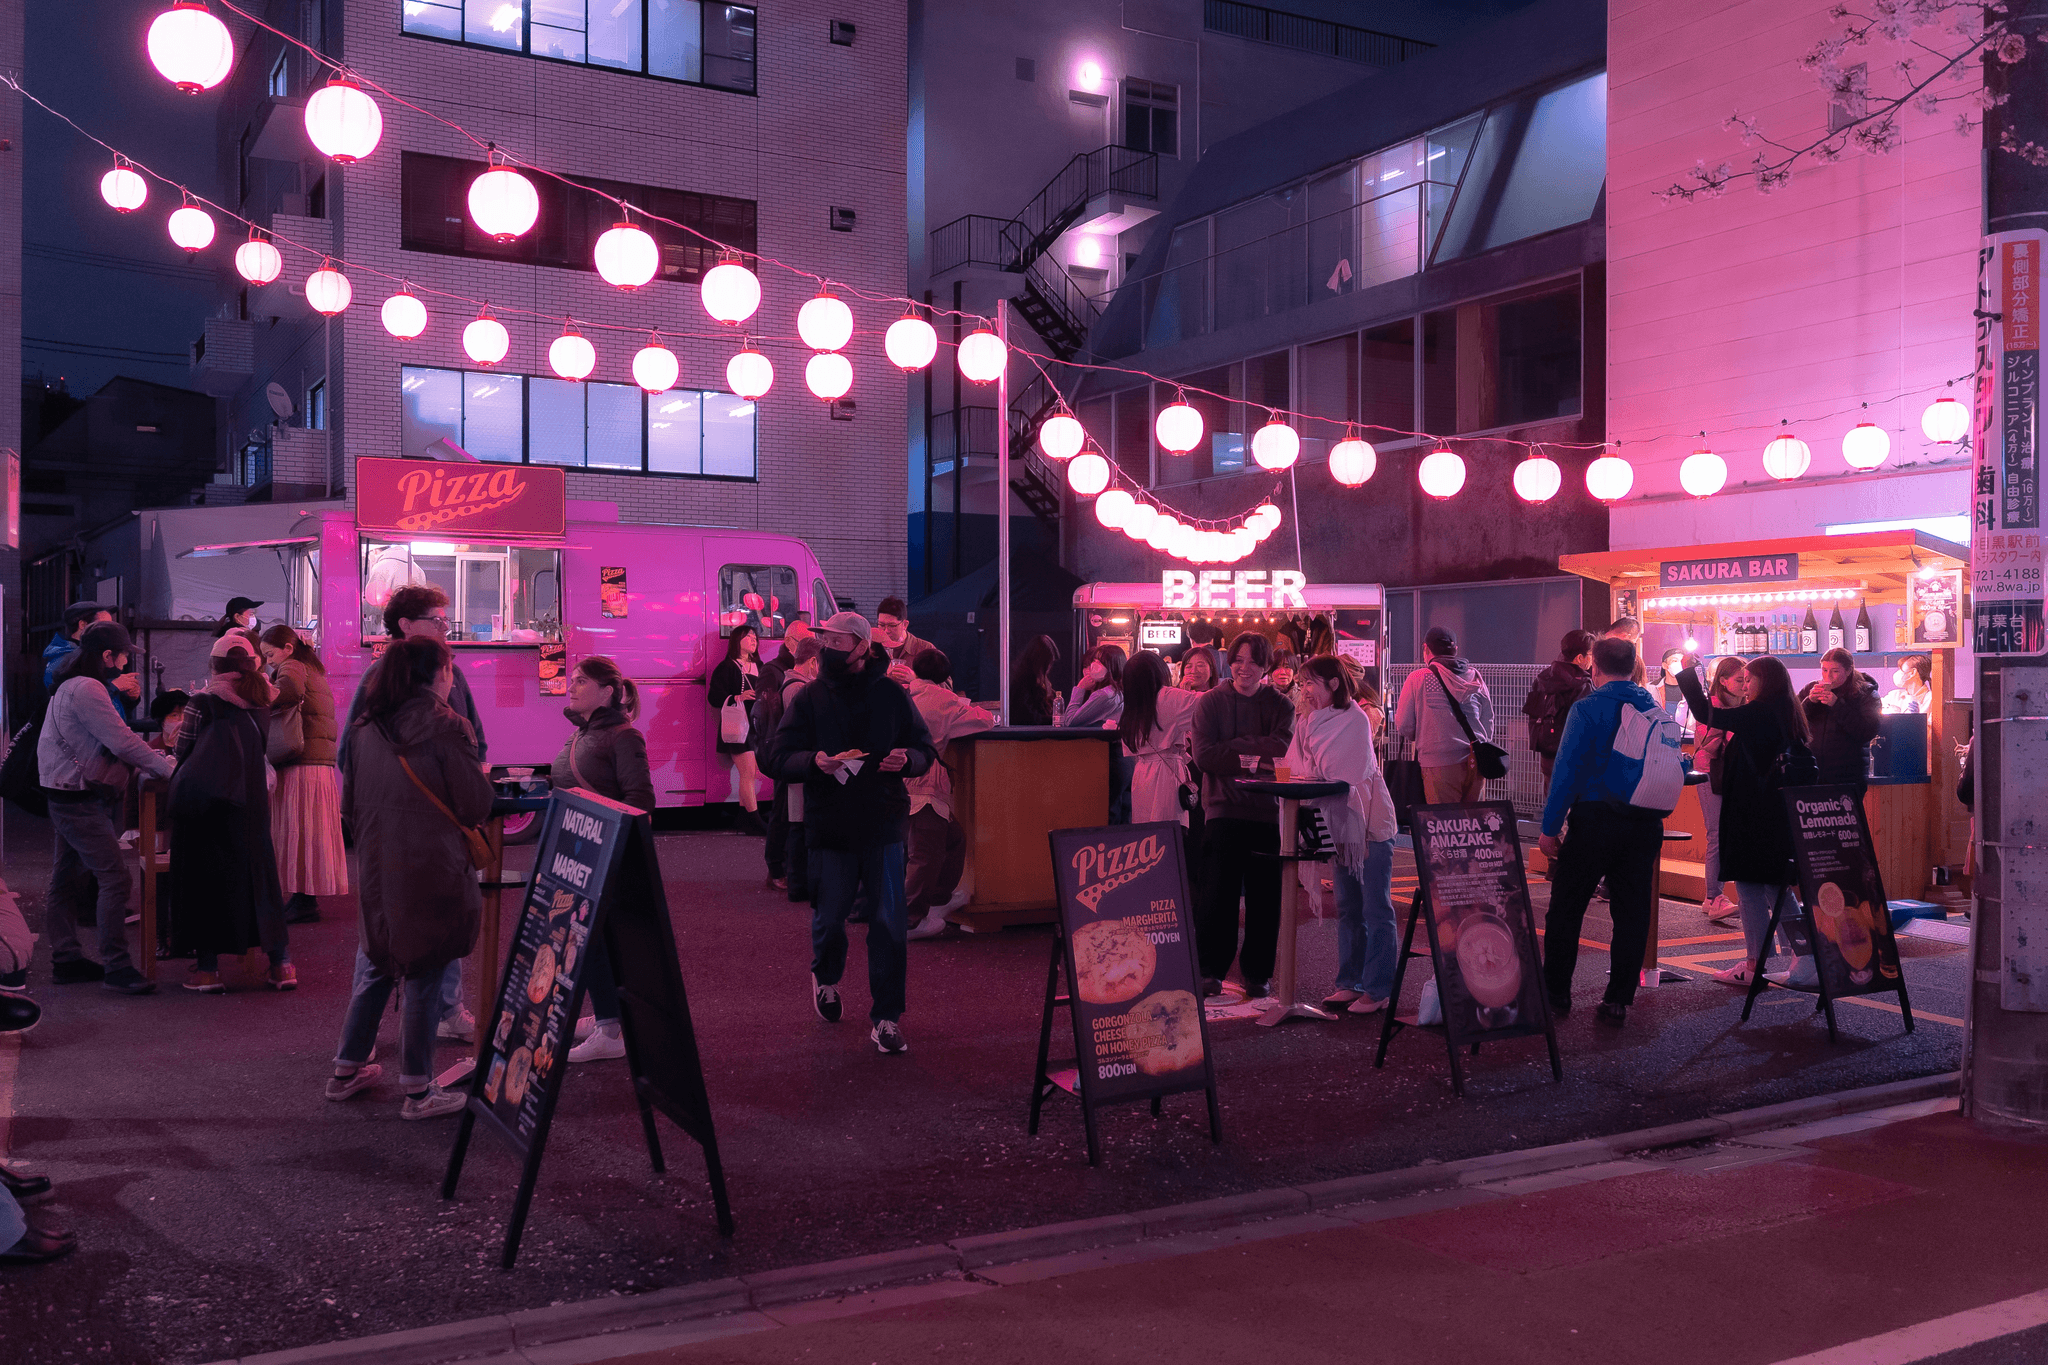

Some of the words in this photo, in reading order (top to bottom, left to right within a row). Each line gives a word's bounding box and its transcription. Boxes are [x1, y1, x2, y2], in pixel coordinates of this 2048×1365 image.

[2011, 243, 2030, 339] 裏側部分矯正
[397, 468, 526, 512] Pizza
[1667, 561, 1743, 582] SAKURA
[1749, 558, 1788, 577] BAR
[1162, 570, 1308, 608] BEER
[1977, 614, 2026, 628] 青葉台
[1147, 629, 1176, 638] BEER
[1796, 798, 1840, 815] Organic
[562, 808, 603, 845] NATURAL
[1426, 818, 1482, 833] SAKURA
[1799, 812, 1857, 829] Lemonade
[1430, 832, 1494, 848] AMAZAKE
[1071, 834, 1165, 886] Pizza
[552, 852, 592, 889] MARKET
[1150, 899, 1176, 911] PIZZA
[1122, 911, 1178, 927] MARGHERITA
[1092, 1011, 1152, 1030] GORGONZOLA
[1094, 1028, 1126, 1042] CHEESE
[1095, 1044, 1109, 1055] ON
[1110, 1040, 1140, 1054] HONEY
[1142, 1035, 1168, 1049] PIZZA
